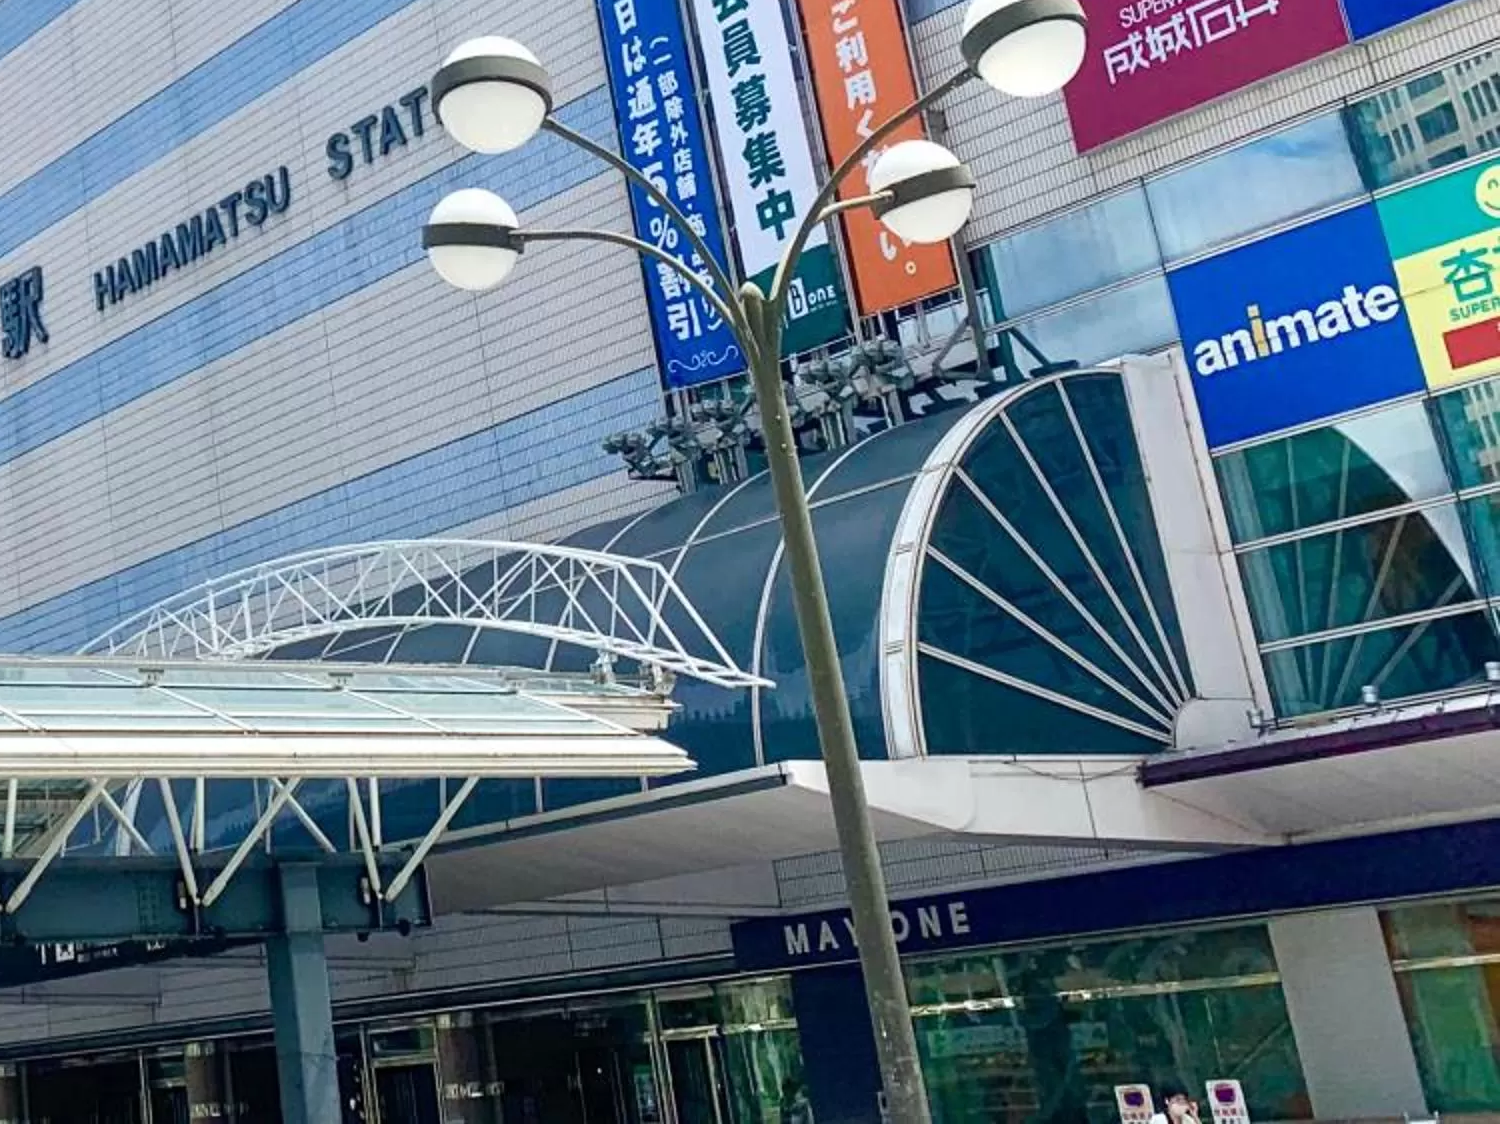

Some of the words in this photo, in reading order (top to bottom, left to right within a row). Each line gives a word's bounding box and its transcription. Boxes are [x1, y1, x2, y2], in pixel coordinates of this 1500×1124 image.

[93, 166, 292, 311] HAMAMATSU
[326, 86, 429, 180] STAT
[1440, 236, 1500, 303] 杏
[1195, 278, 1399, 376] animate
